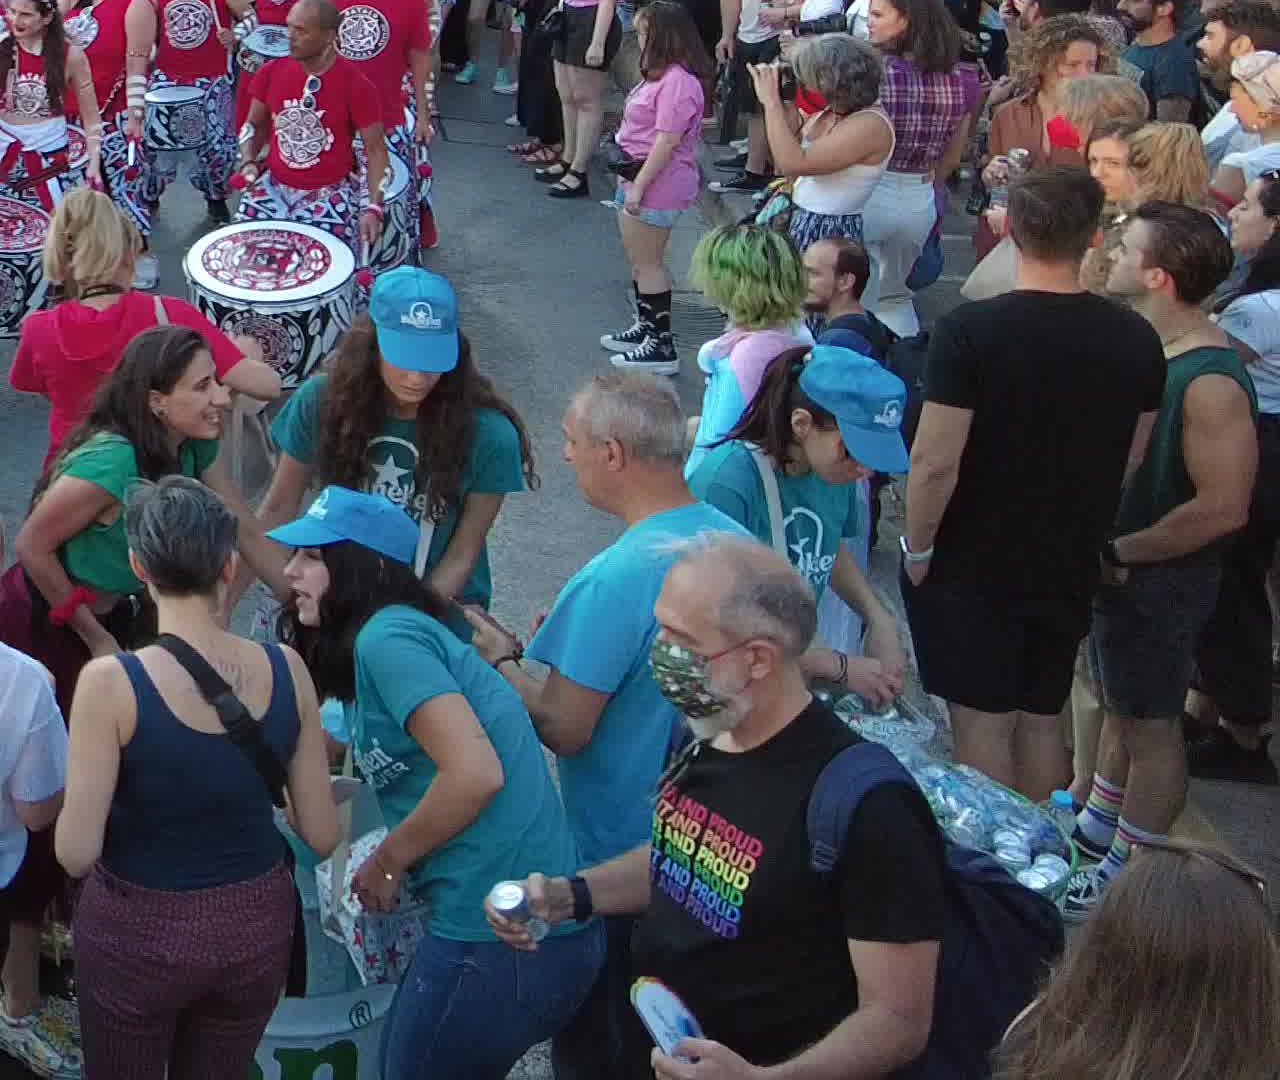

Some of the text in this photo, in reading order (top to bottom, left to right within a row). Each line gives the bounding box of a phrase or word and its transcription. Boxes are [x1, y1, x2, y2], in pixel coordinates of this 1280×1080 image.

[664, 825, 696, 855] AND
[695, 845, 750, 890] PROUD
[667, 810, 701, 838] AND
[702, 828, 756, 873] PROUD
[678, 796, 707, 821] AND
[709, 813, 764, 857] PROUD
[660, 858, 741, 923] AND PROUD
[664, 842, 691, 870] AND
[693, 862, 744, 906] PROUD
[686, 894, 739, 938] PROUD
